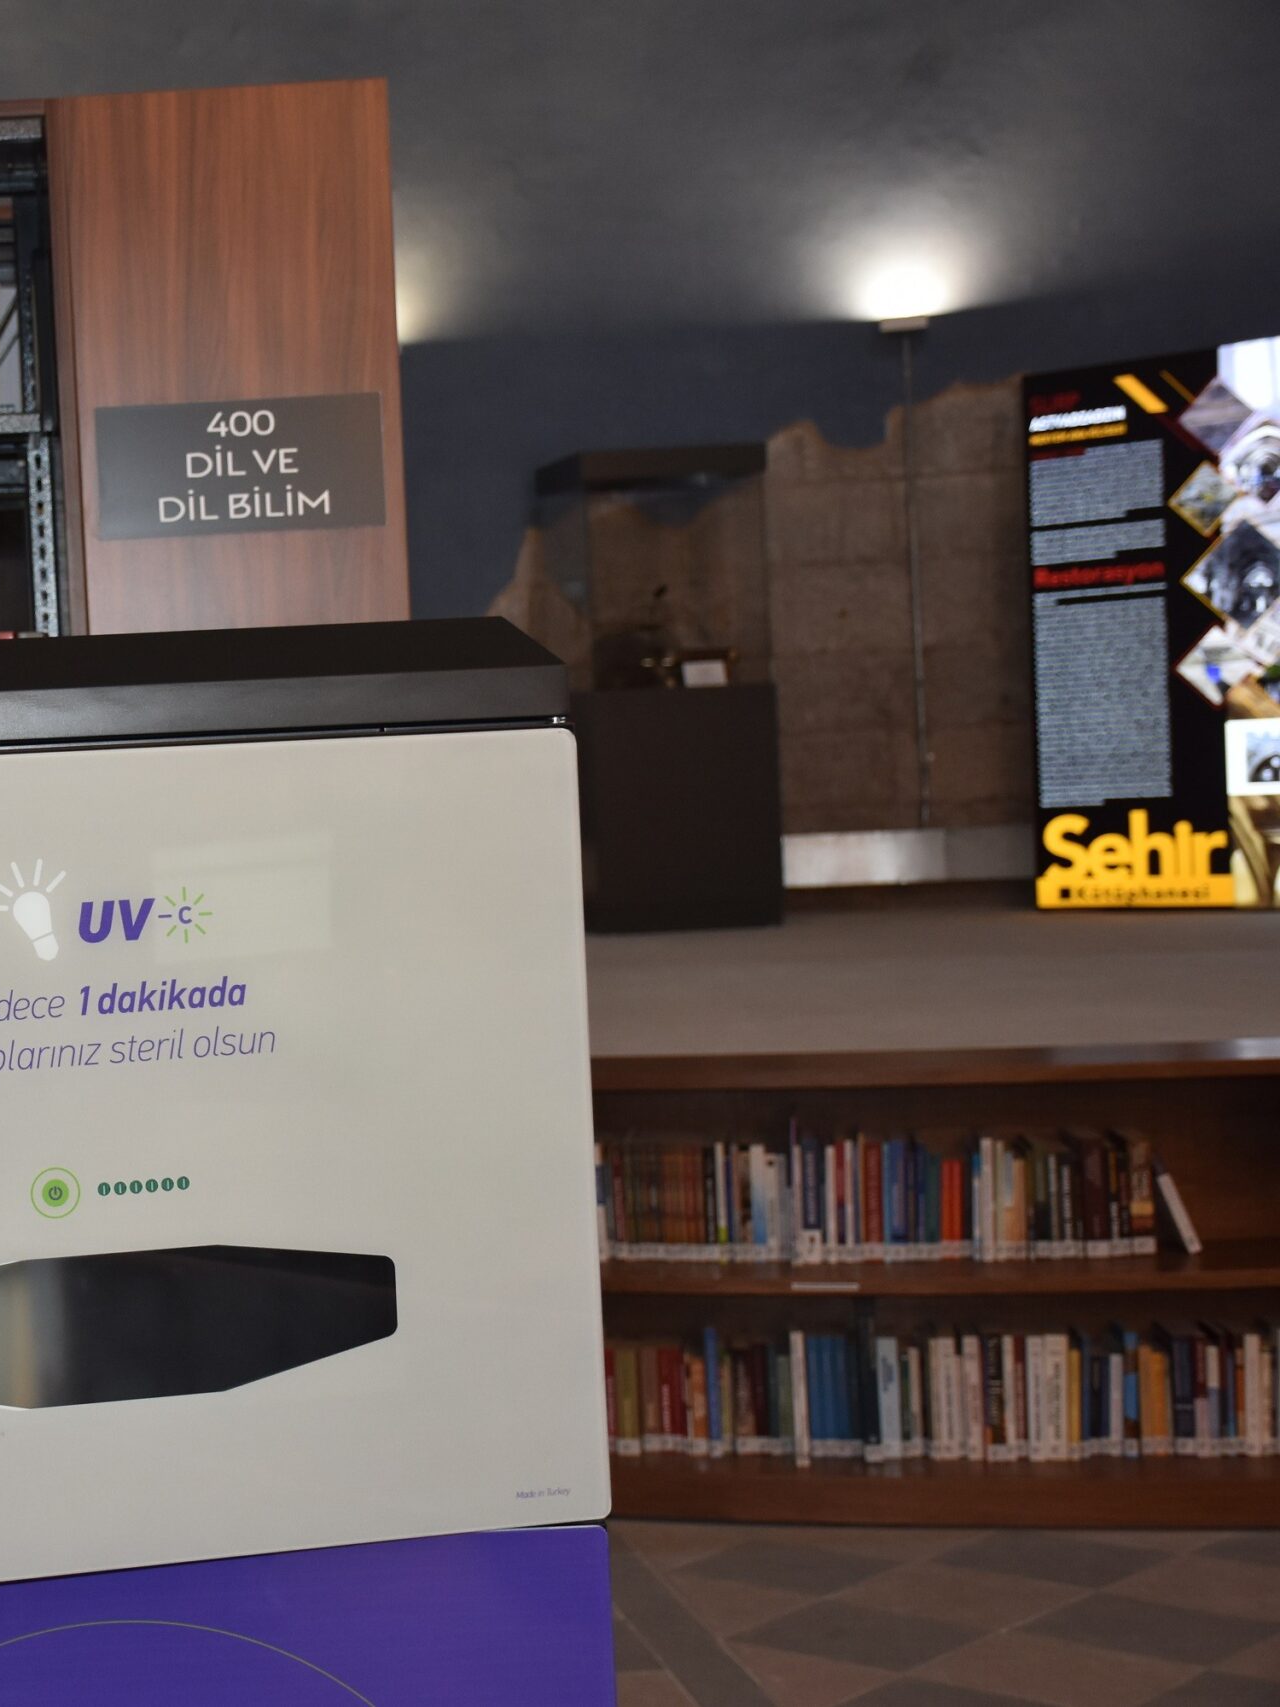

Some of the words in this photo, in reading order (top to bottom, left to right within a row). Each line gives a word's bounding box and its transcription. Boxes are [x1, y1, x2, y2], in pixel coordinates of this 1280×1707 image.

[206, 409, 275, 438] 400
[186, 445, 246, 478] DİL
[252, 447, 299, 474] VE
[158, 489, 219, 523] DİL
[228, 484, 330, 519] BİLİM
[79, 985, 91, 1016] 1
[98, 976, 248, 1014] dakikada
[109, 1028, 184, 1063] steril
[193, 1026, 276, 1058] olsun
[515, 1490, 537, 1499] Made
[546, 1486, 571, 1497] Turkey
